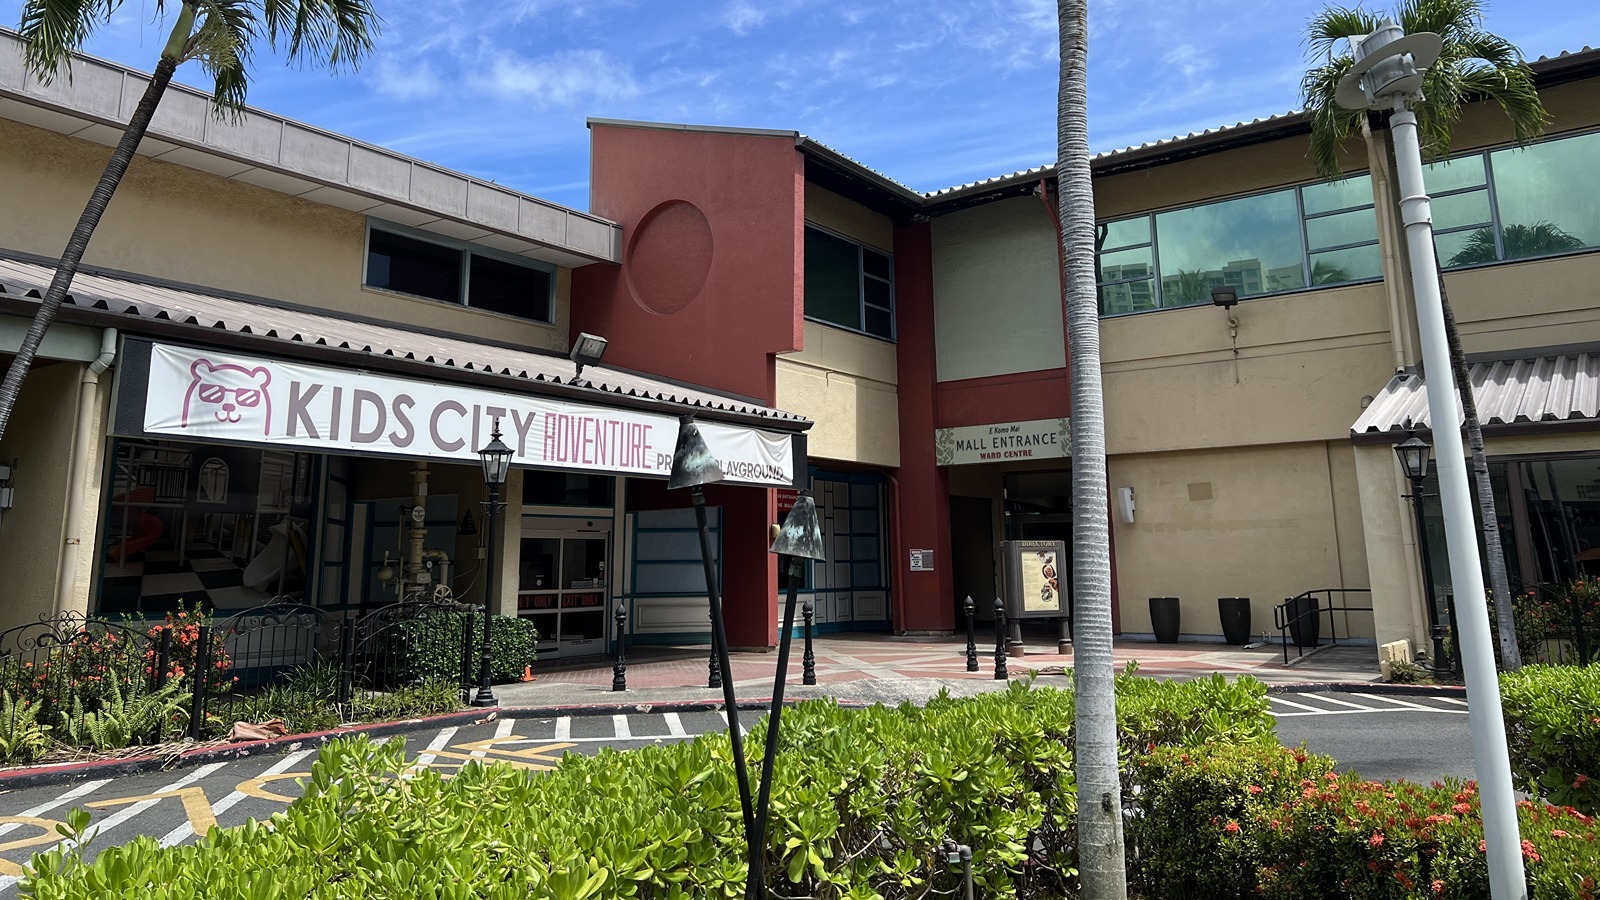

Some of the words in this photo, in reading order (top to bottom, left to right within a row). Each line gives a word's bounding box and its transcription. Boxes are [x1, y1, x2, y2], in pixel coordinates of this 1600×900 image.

[286, 381, 416, 448] KIDS
[429, 400, 536, 458] CITY
[543, 412, 652, 469] ADVENTURE
[956, 439, 987, 451] MALL
[993, 433, 1057, 448] ENTRANCE
[980, 452, 1001, 460] WARD
[1004, 449, 1033, 458] CENTRE
[534, 595, 553, 608] ONLY
[563, 594, 578, 606] EXIT
[582, 594, 599, 605] ONLY
